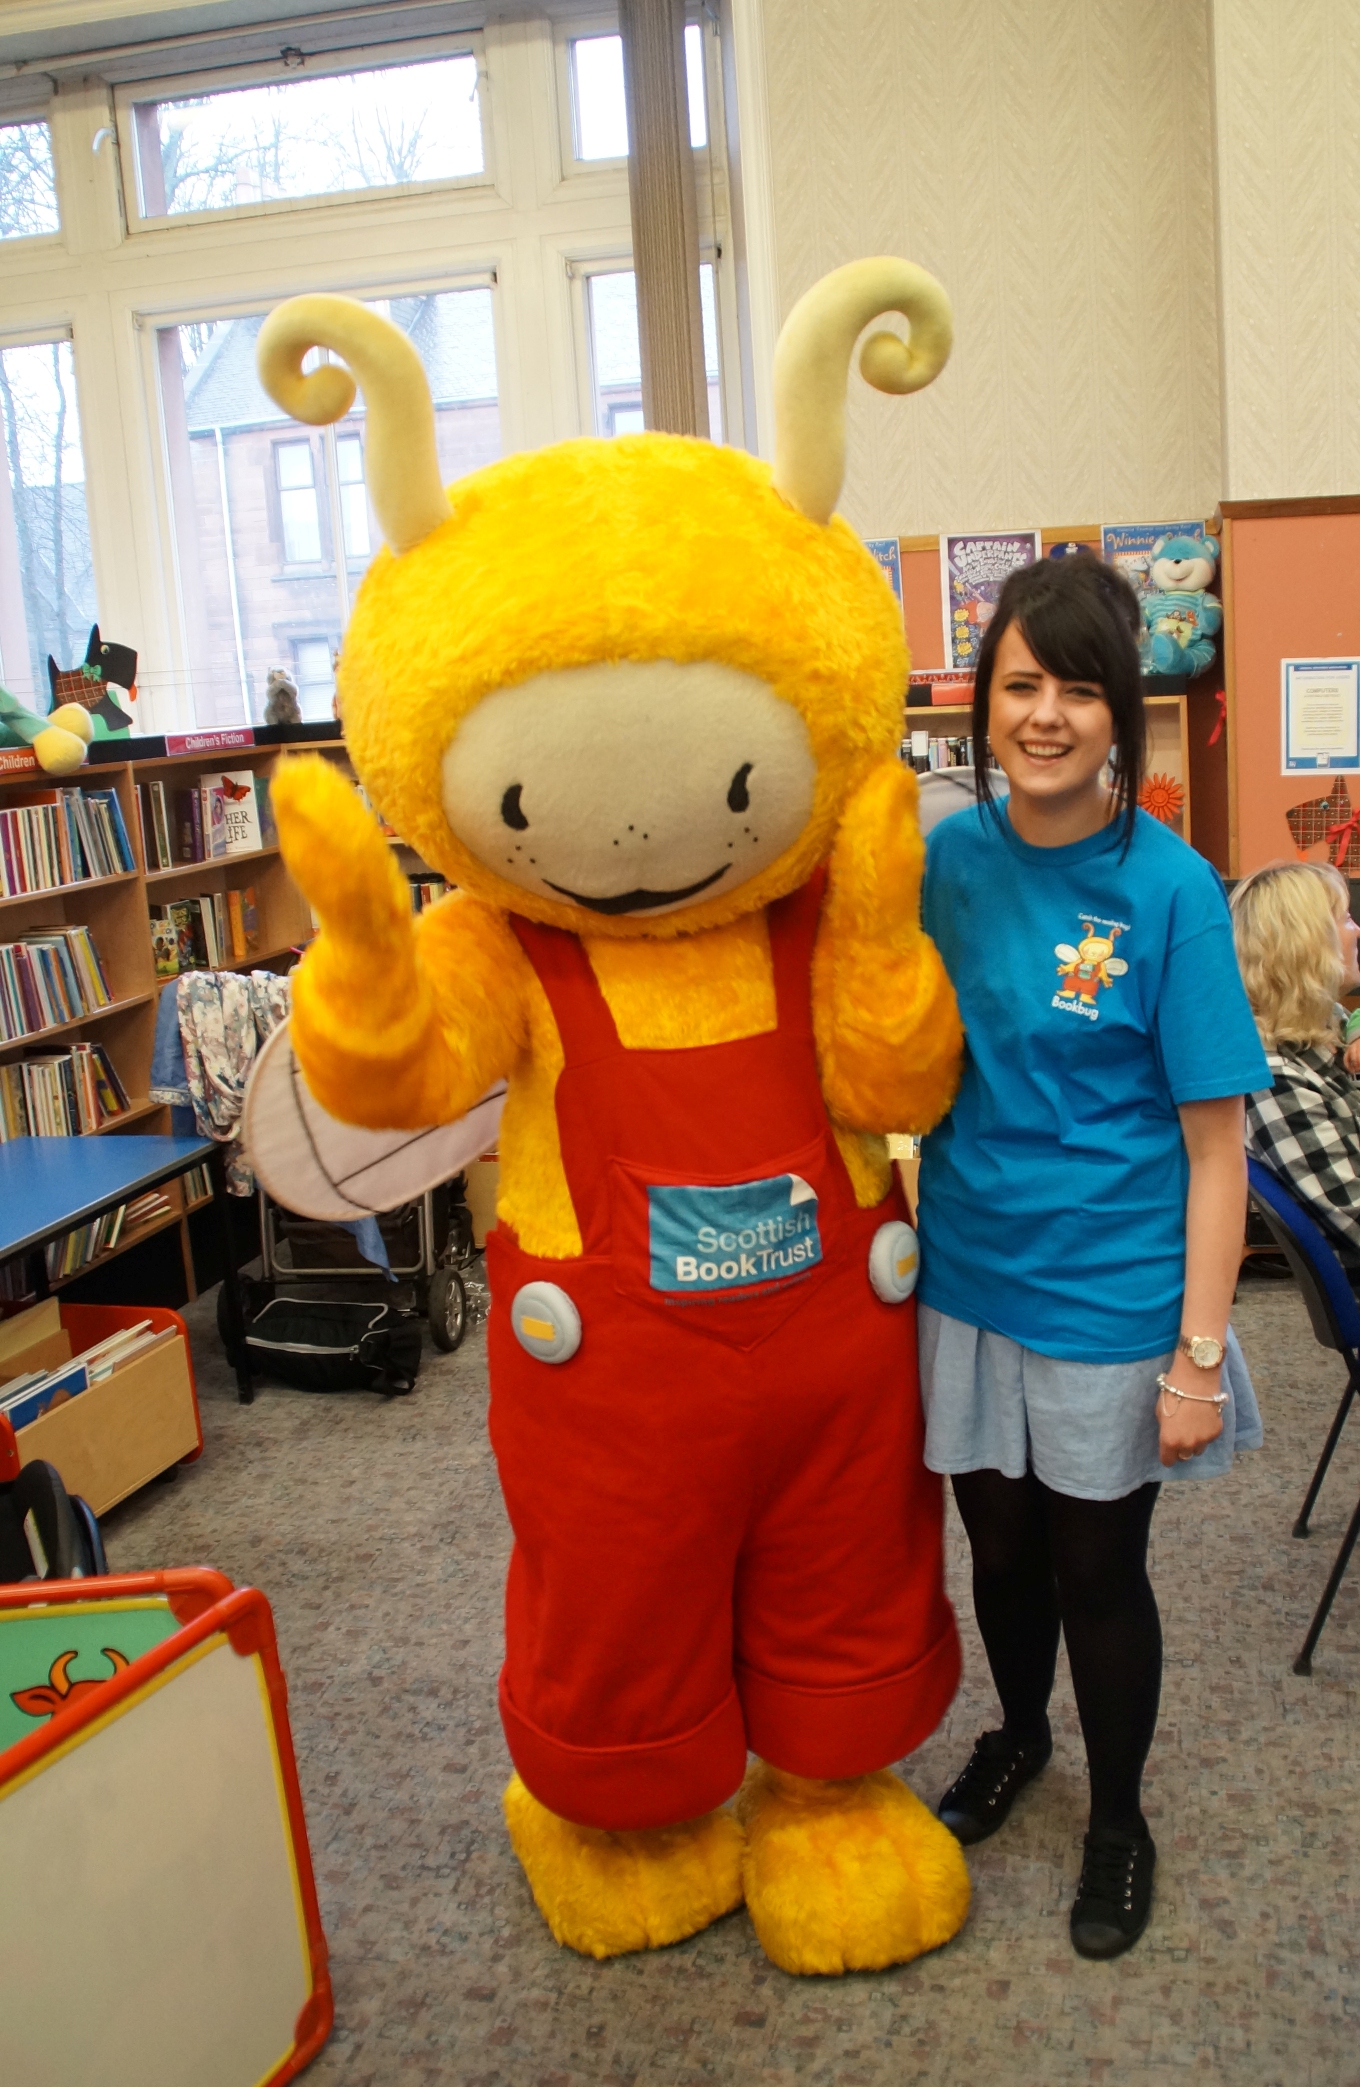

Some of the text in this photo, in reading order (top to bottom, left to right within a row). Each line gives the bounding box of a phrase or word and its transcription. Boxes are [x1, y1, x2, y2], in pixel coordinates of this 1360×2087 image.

[953, 540, 1021, 556] CAPTAIN
[1106, 532, 1154, 549] Winnie
[185, 732, 245, 750] Children's Fiction
[1051, 995, 1099, 1021] Bookbug
[697, 1211, 811, 1253] Scottish
